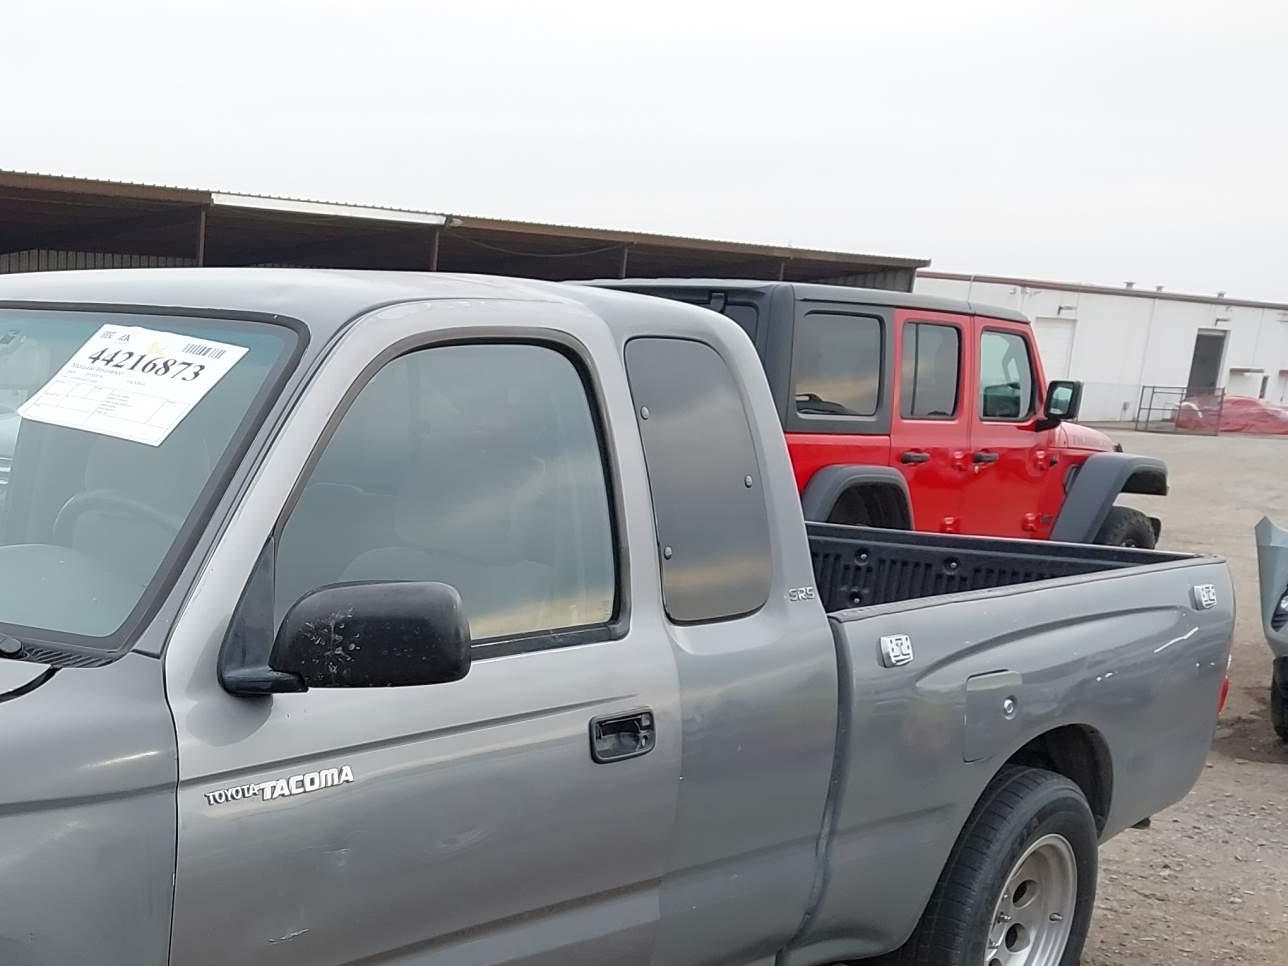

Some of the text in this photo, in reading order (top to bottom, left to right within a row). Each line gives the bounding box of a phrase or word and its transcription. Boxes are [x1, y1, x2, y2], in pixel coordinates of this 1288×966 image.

[88, 346, 206, 382] 44216873
[204, 765, 354, 805] TOYOTA TACOMA
